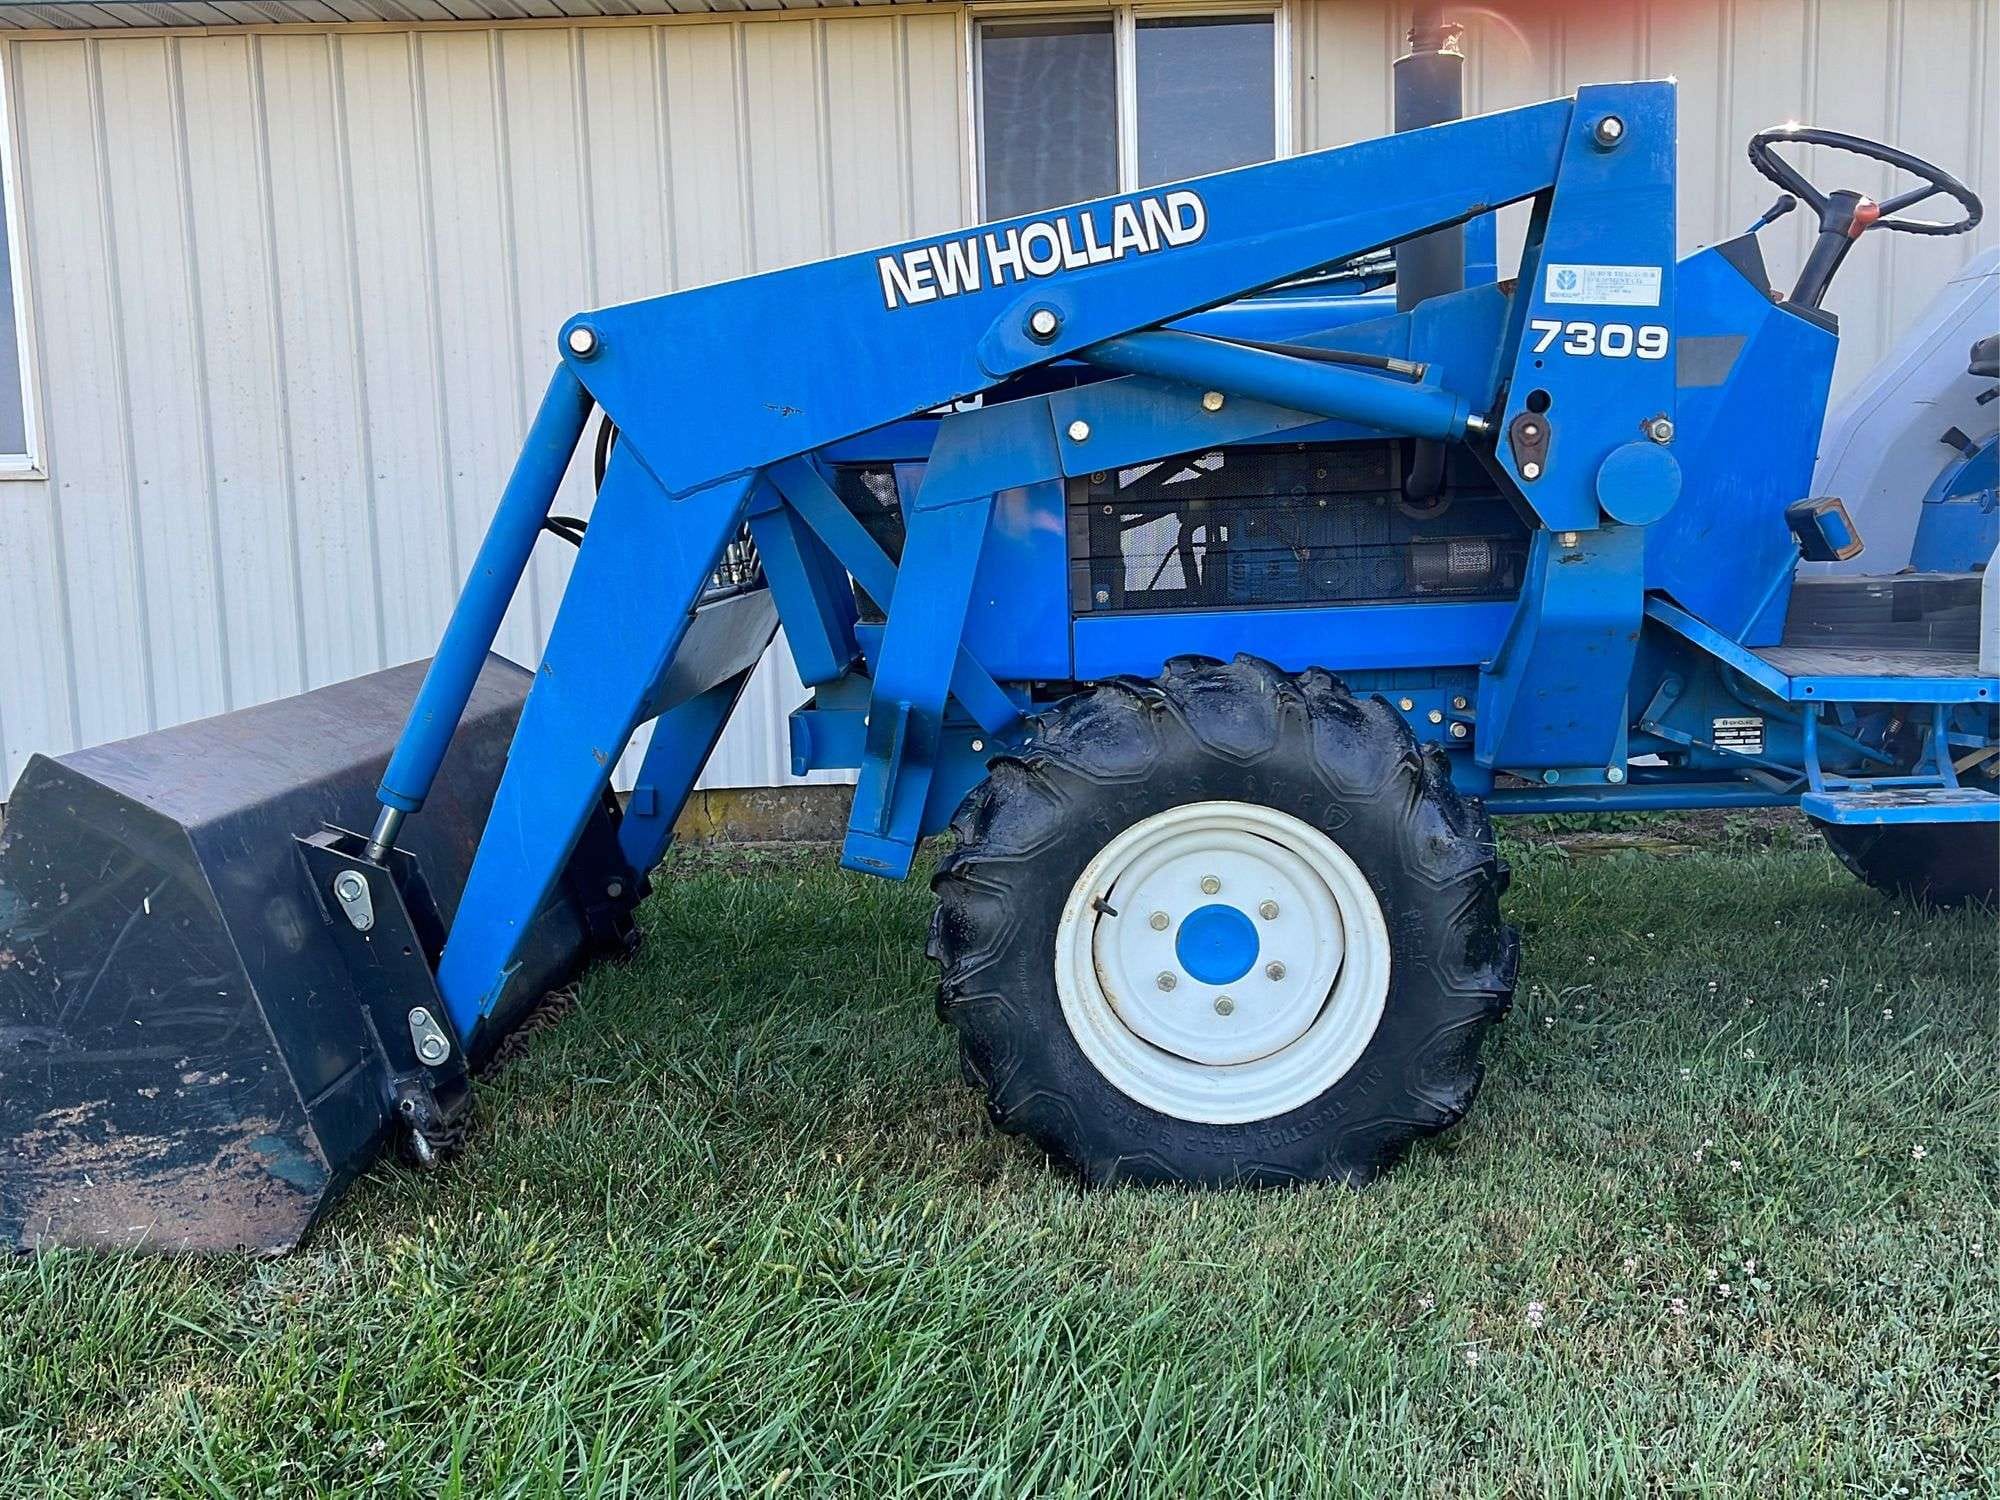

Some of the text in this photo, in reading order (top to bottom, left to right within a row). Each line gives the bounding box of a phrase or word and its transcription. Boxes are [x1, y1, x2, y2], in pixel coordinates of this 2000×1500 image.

[878, 190, 1208, 311] NEW HOLLAND
[1530, 318, 1670, 360] 7309
